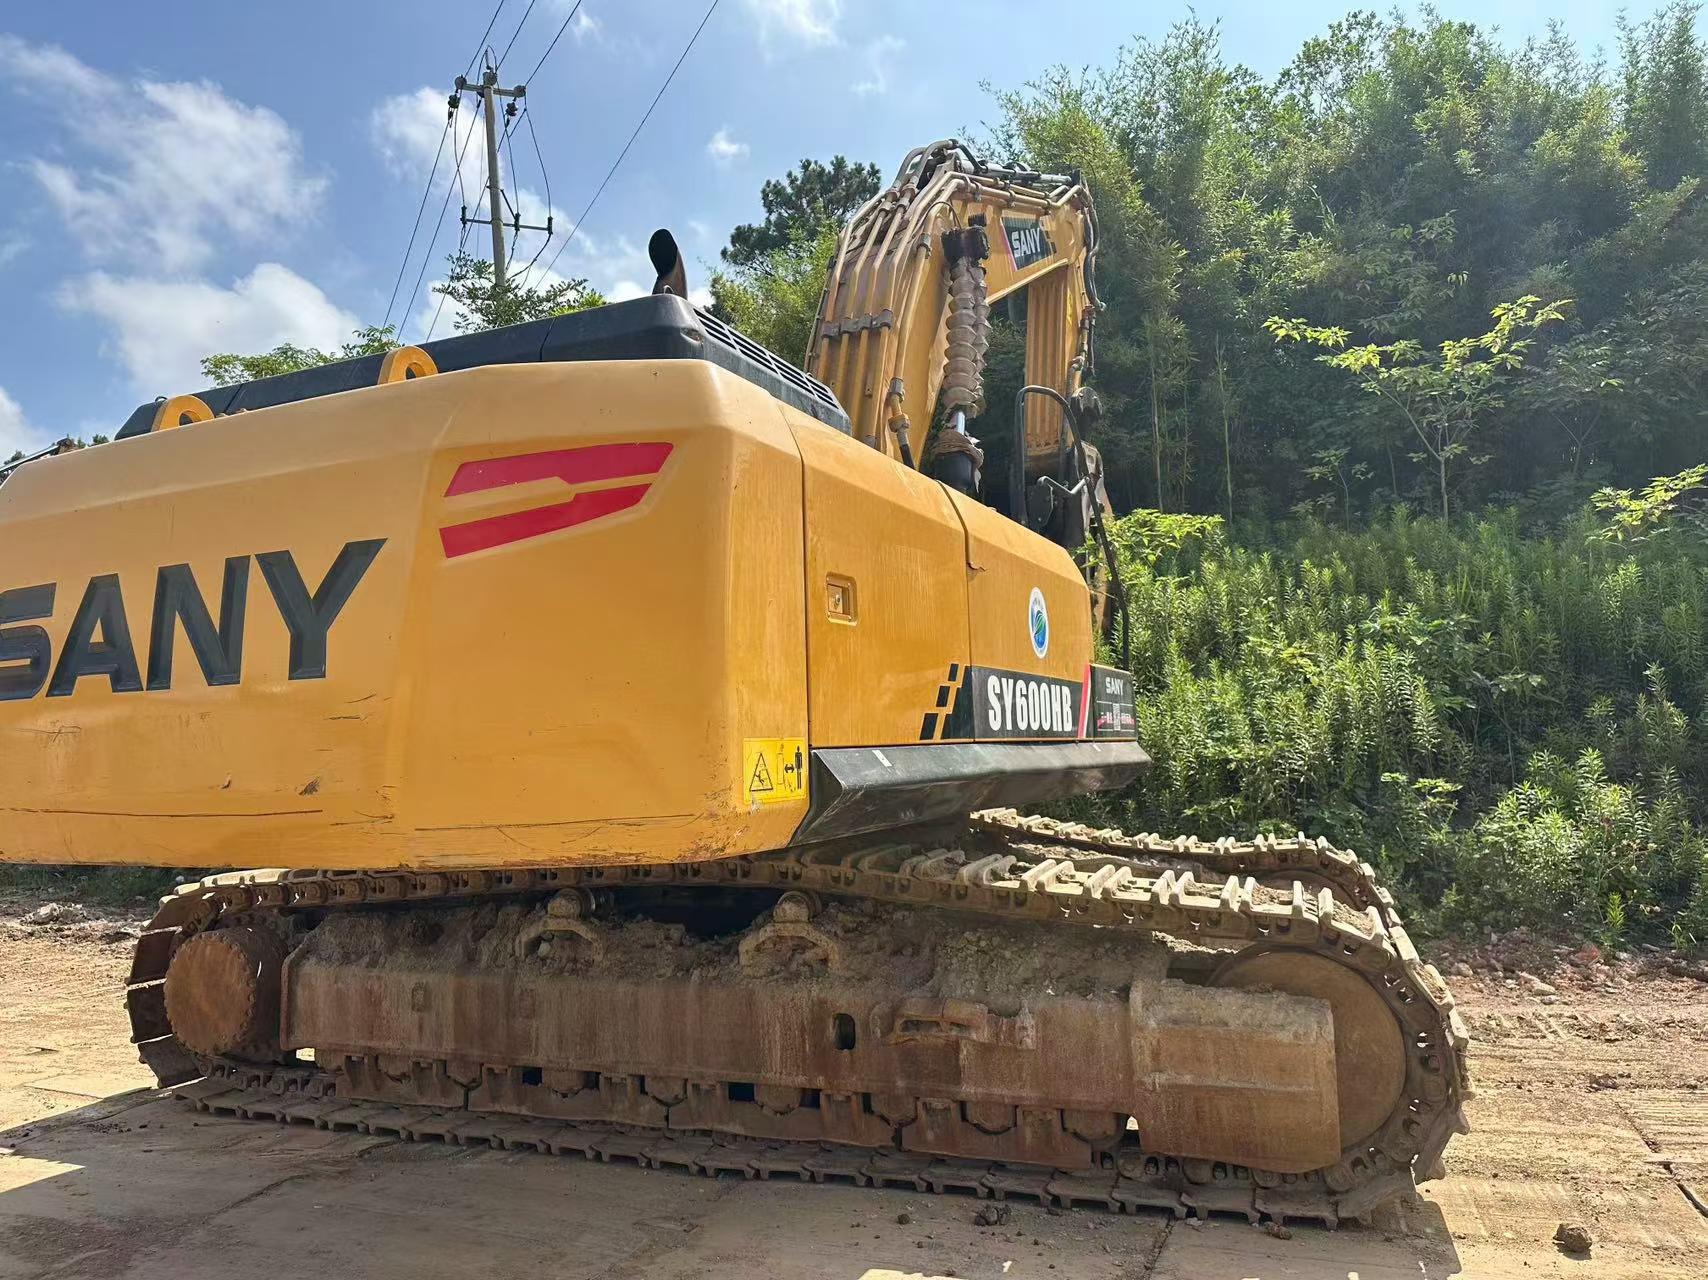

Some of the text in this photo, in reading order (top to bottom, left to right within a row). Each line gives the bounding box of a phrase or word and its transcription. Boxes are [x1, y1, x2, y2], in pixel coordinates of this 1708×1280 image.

[1011, 228, 1041, 258] SANY
[0, 538, 388, 700] SANY
[987, 675, 1073, 732] SY600HB
[1105, 677, 1124, 695] SANY
